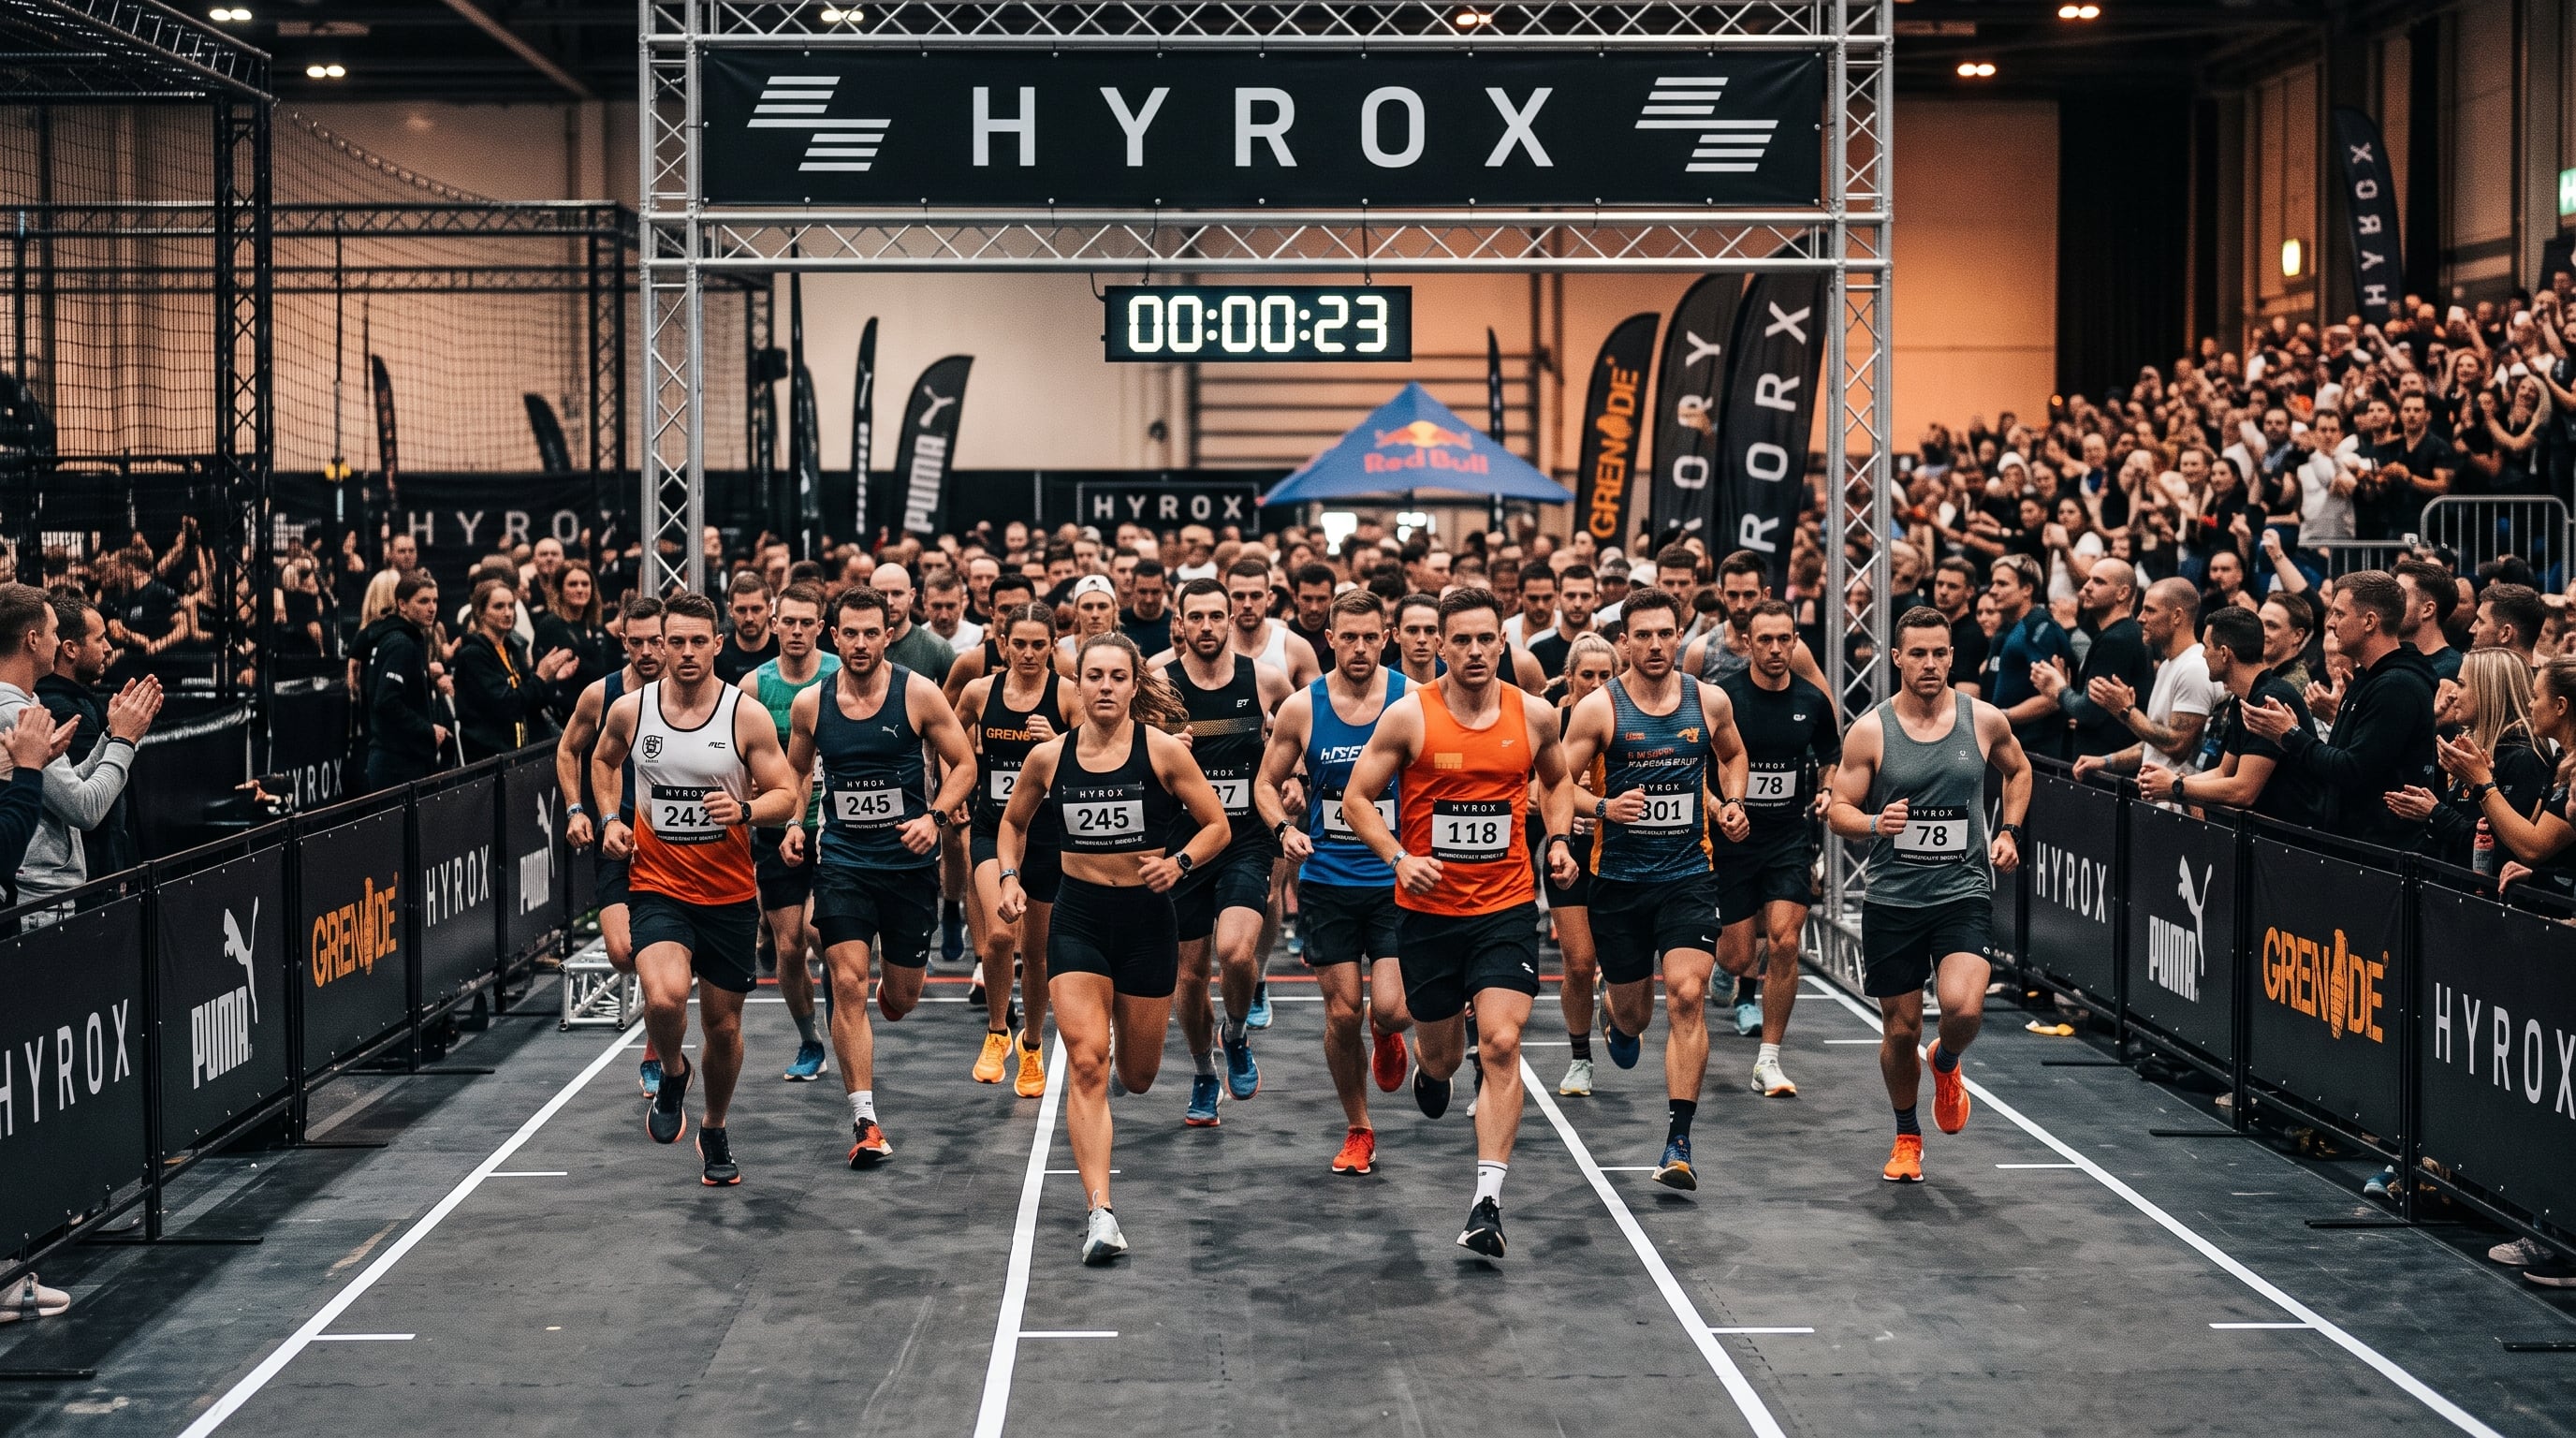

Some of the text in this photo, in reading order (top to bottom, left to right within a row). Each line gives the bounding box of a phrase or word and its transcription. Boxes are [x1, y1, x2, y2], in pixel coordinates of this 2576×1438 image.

[973, 86, 1554, 168] HYROX
[2349, 141, 2387, 306] HYROX
[1128, 295, 1387, 352] 00:00:23
[902, 434, 947, 535] PUMA
[1364, 448, 1489, 475] Red Bull
[1093, 494, 1242, 521] HYROX
[286, 757, 343, 808] YROX
[846, 794, 890, 815] 245
[1079, 789, 1124, 799] HYROX
[1757, 776, 1783, 795] 78
[1077, 807, 1129, 830] 245
[1448, 822, 1498, 844] 118
[1912, 809, 1954, 817] HYROX
[1916, 826, 1948, 846] 78
[426, 844, 489, 927] HYROX
[520, 846, 549, 916] PUMA
[2037, 841, 2106, 923] HYROX
[2149, 915, 2195, 1002] PUMA
[191, 986, 249, 1090] PUMA
[2436, 982, 2576, 1121] HYROX
